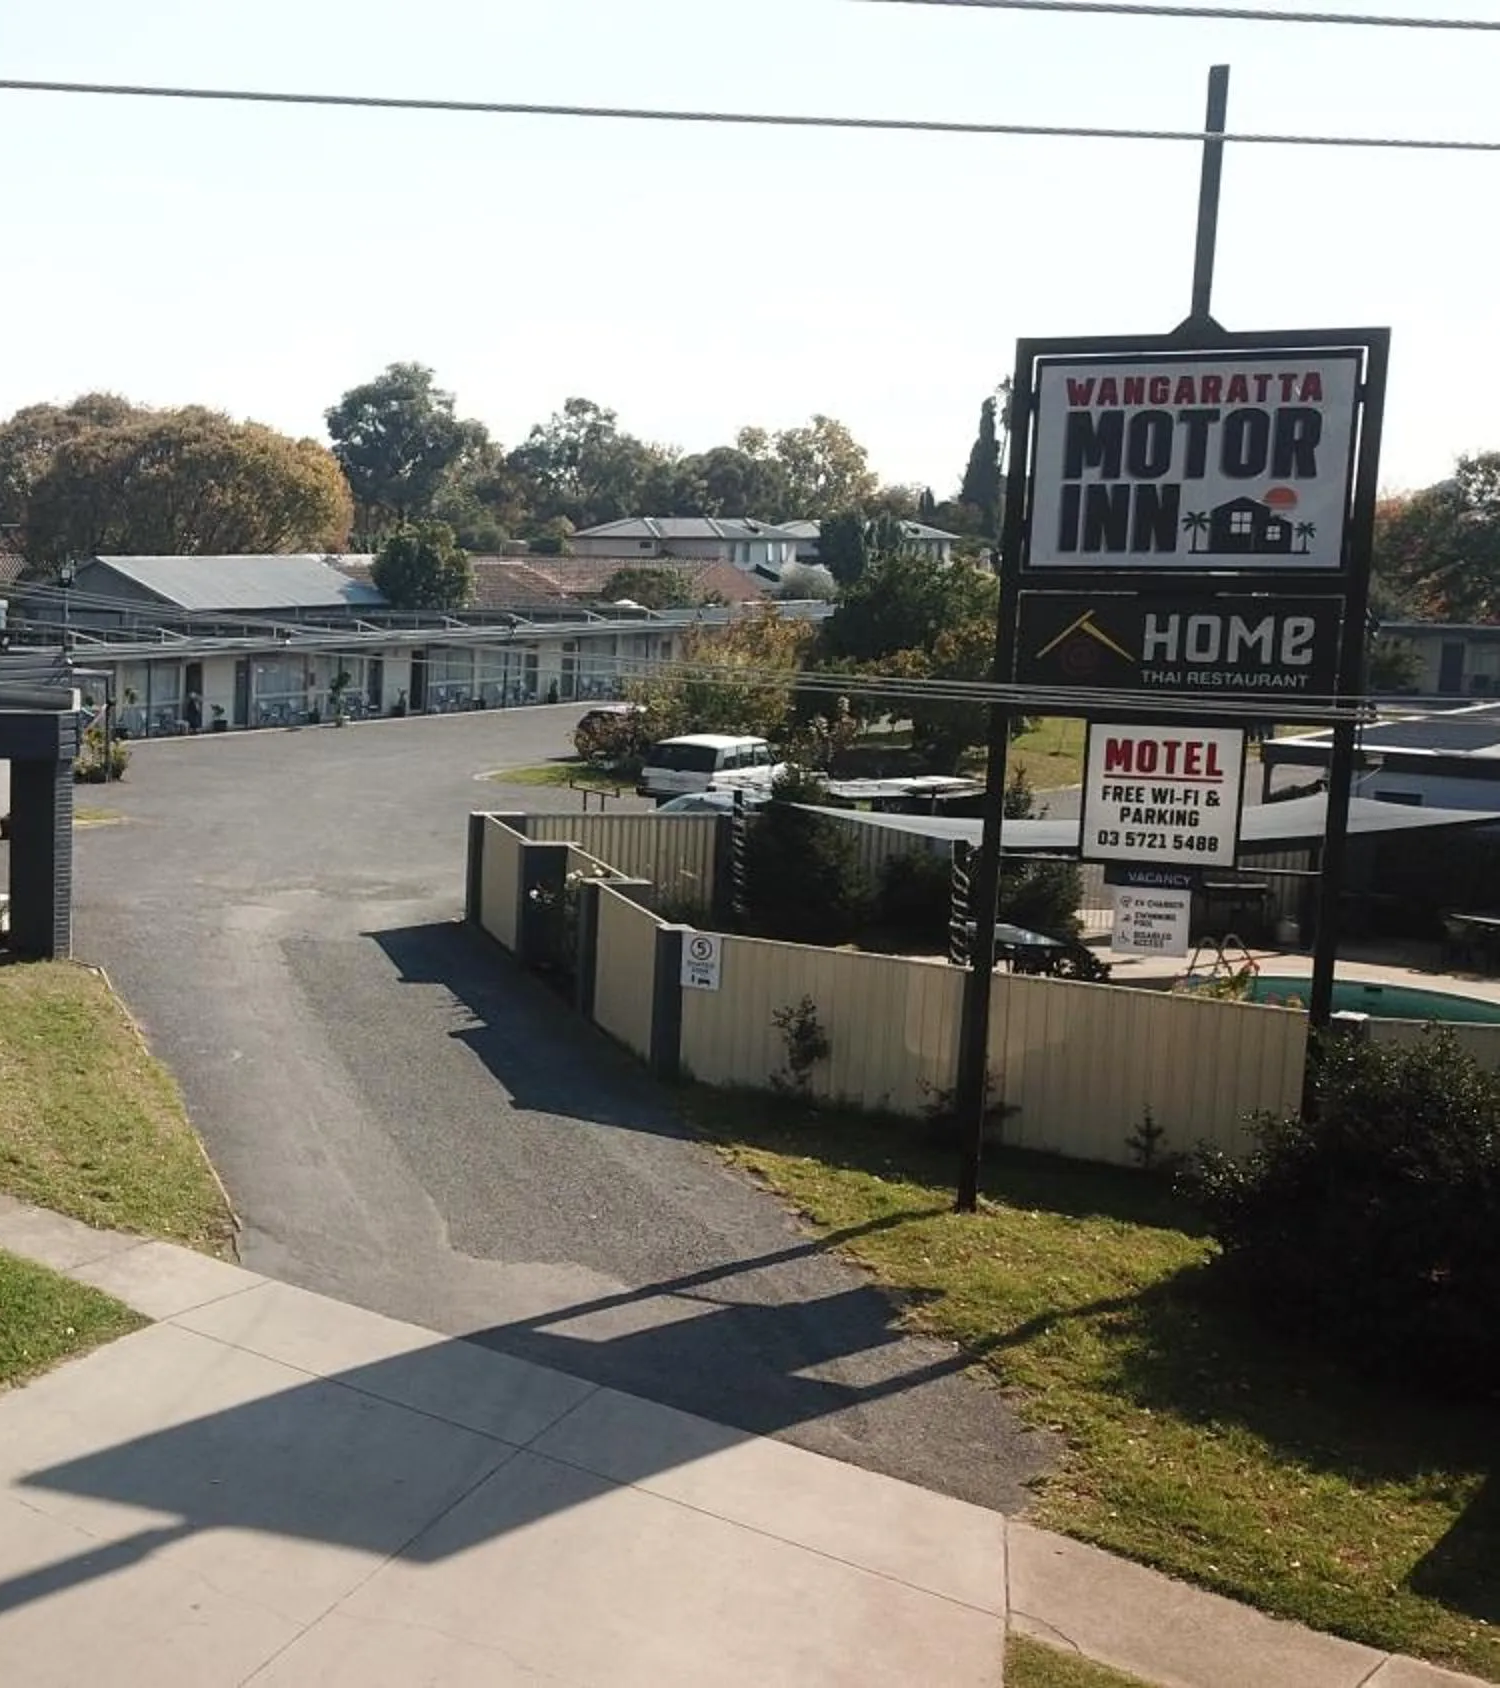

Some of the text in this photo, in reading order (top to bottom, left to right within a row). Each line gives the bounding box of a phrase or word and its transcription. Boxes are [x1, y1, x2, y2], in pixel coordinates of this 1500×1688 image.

[1065, 371, 1324, 407] WANGARATTA
[1061, 407, 1324, 480] MOTOR
[1057, 483, 1181, 553] INN
[1141, 670, 1309, 689] THAI RESTAURANT
[1104, 738, 1224, 777] MOTEL
[1101, 785, 1221, 807] FREE WI-FI &
[1119, 807, 1200, 827] PARKING
[1097, 830, 1219, 852] 03 5721 5488
[1127, 870, 1192, 887] VACANCY
[697, 941, 707, 956] 5
